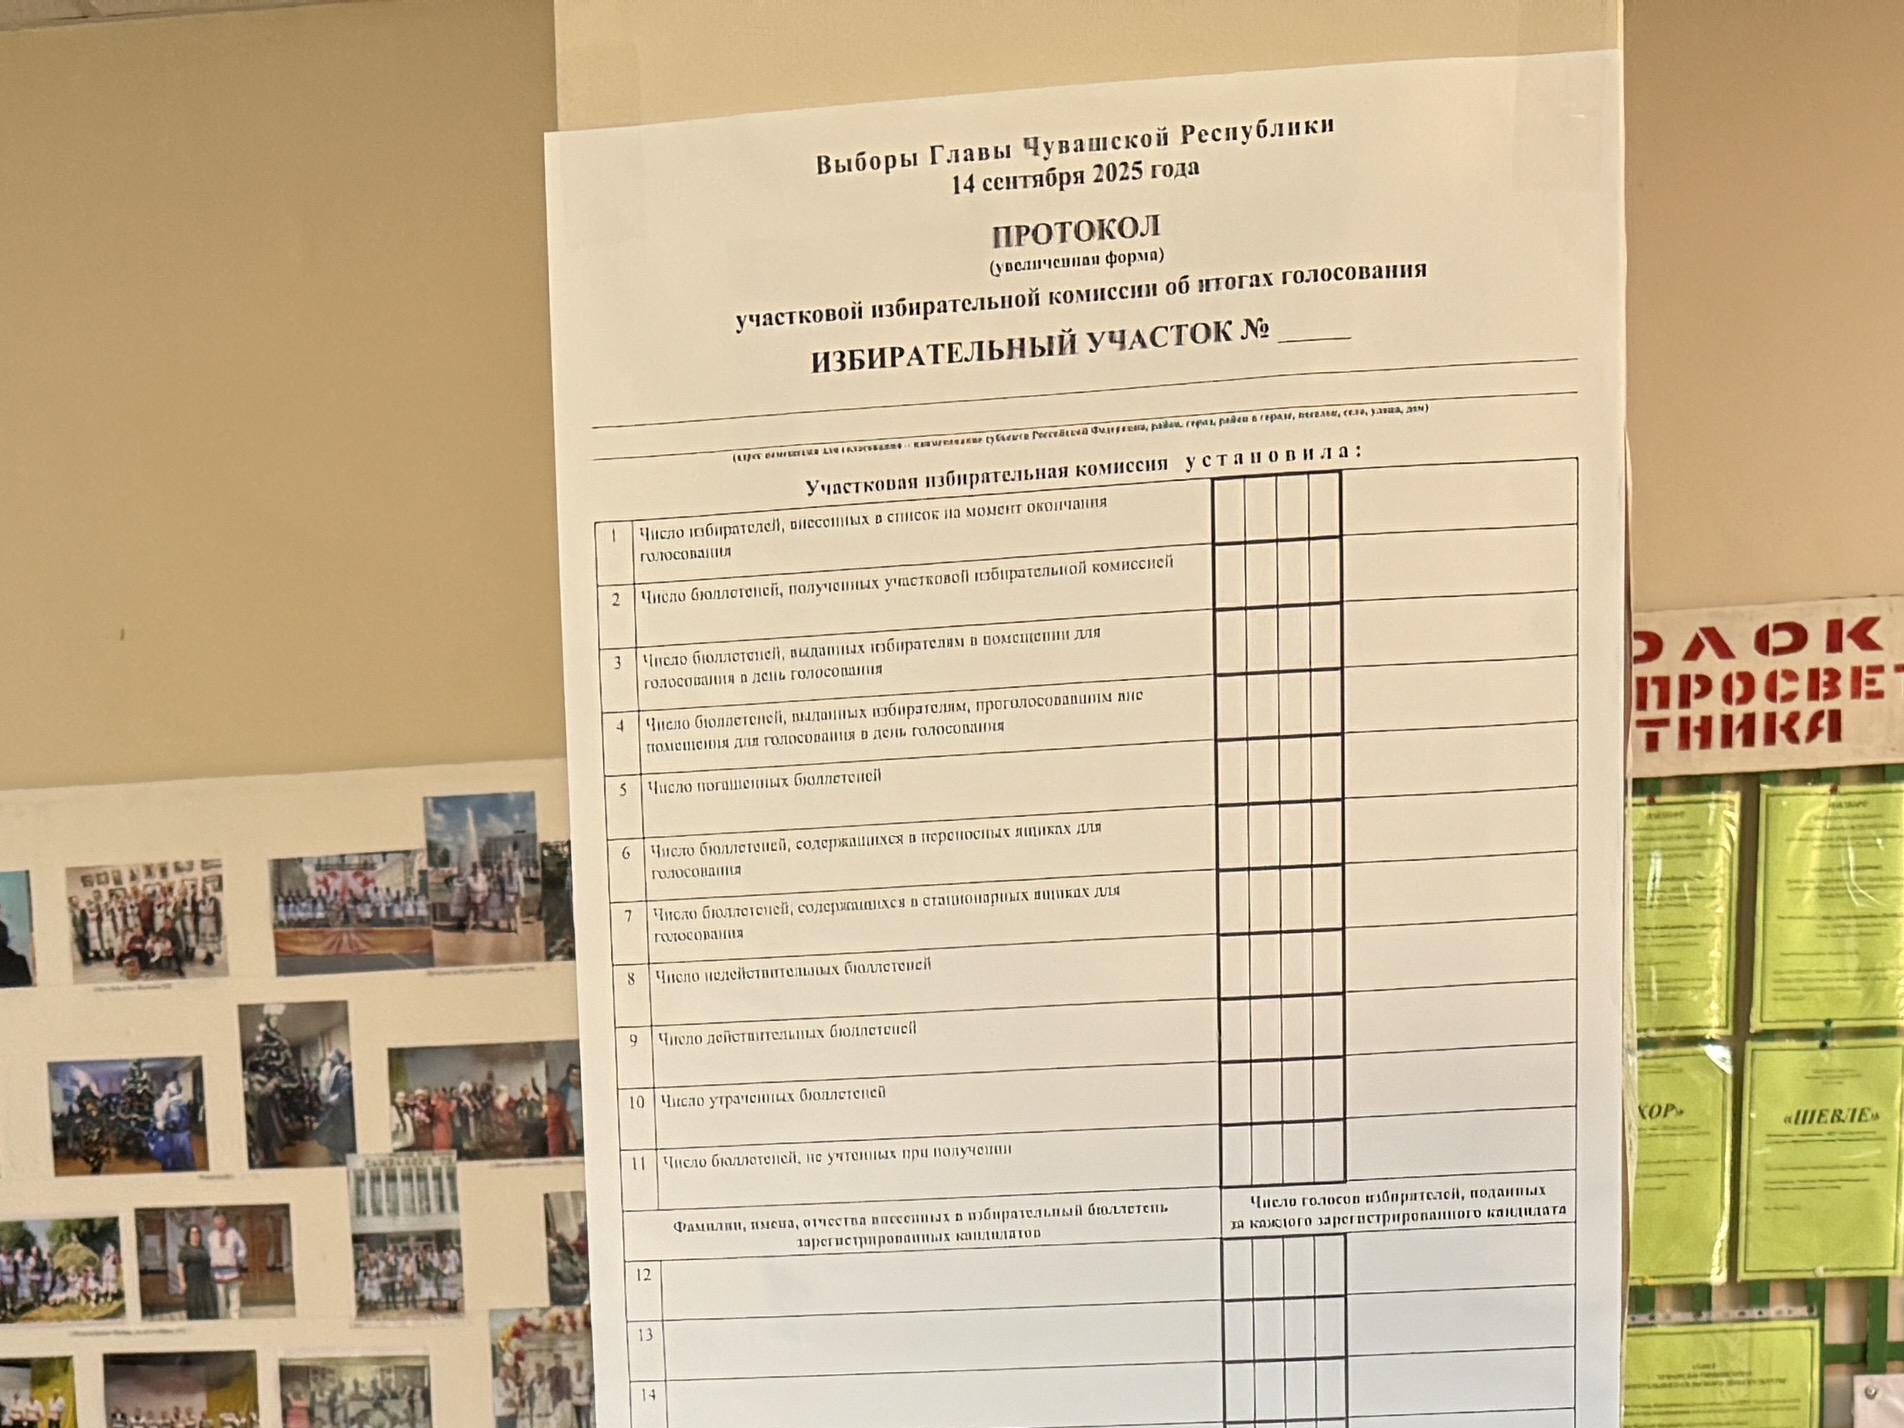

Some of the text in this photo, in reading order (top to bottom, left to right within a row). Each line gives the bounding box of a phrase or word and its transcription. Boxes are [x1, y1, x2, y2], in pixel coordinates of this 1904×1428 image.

[815, 117, 1335, 176] Выборы Главы Чувашской Республики
[952, 159, 1201, 196] 14 сентября 2025 года
[991, 213, 1161, 250] ПРОТОКОЛ
[734, 262, 1428, 336] участковой избирательной комиссии об итогах голосования
[811, 316, 1271, 375] ИЗБИРАТЕЛЬНЫЙ УЧАСТОК №
[804, 476, 919, 498] Участковая
[924, 465, 1070, 491] избирательная
[1074, 457, 1169, 478] комиссия
[612, 528, 616, 542] 1
[612, 592, 620, 607] 2
[614, 656, 621, 670] 3
[616, 719, 624, 732] 4
[1635, 709, 1842, 752] ТНИКА
[620, 782, 627, 797] 5
[622, 846, 630, 859] 6
[624, 909, 632, 922] 7
[628, 972, 635, 985] 8
[630, 1034, 637, 1047] 9
[630, 1095, 644, 1109] 10
[1784, 1105, 1880, 1127] «ШЕВЛЕ»
[632, 1156, 645, 1171] 11
[637, 1268, 651, 1281] 12
[639, 1328, 653, 1342] 13
[642, 1388, 656, 1402] 14
